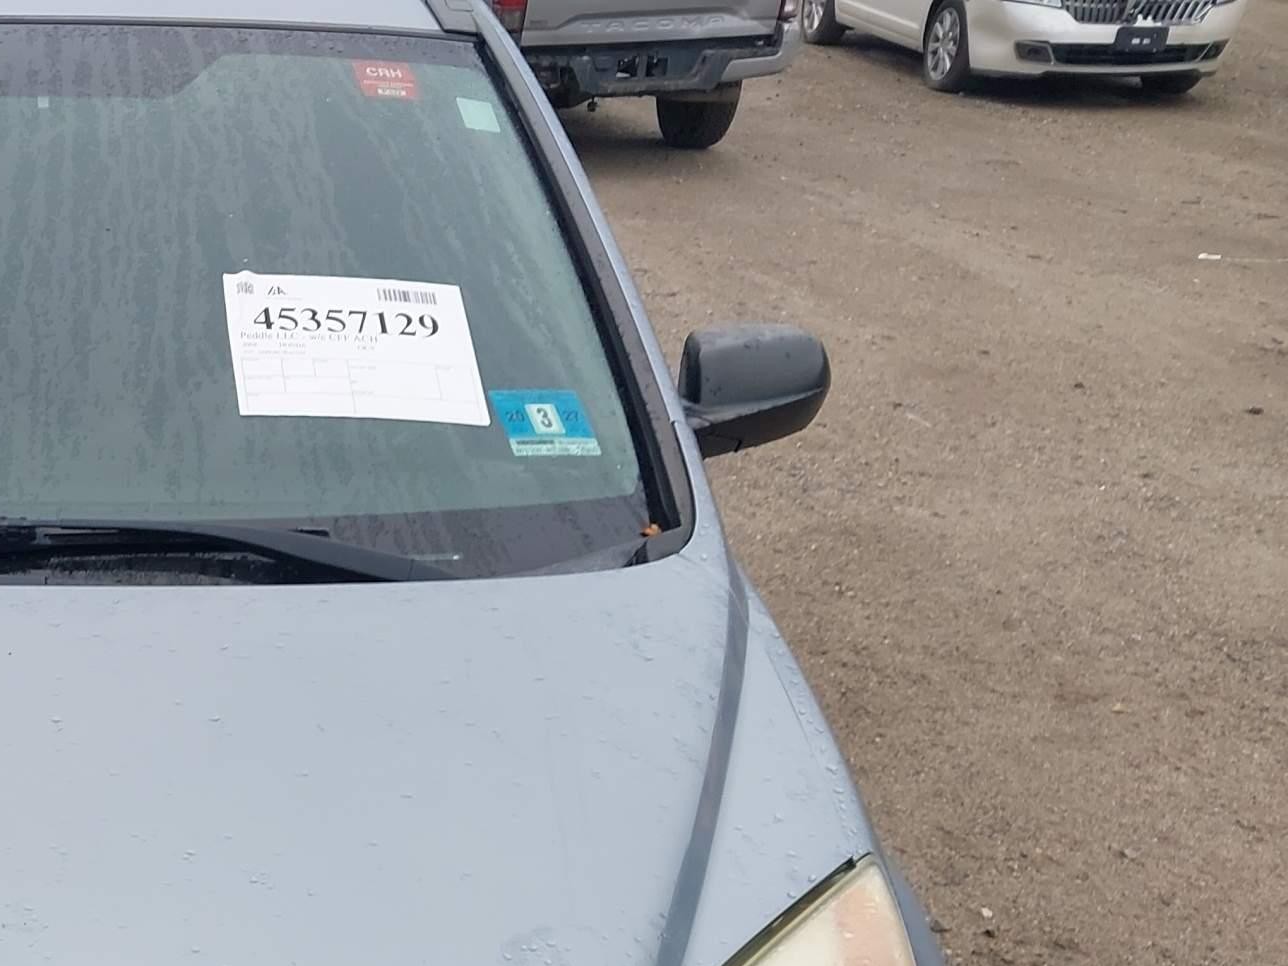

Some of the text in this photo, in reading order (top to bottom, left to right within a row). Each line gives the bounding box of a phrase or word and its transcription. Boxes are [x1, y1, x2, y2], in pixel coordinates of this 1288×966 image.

[580, 15, 725, 33] TACOMA
[253, 306, 440, 338] 45357129
[536, 407, 553, 429] 3
